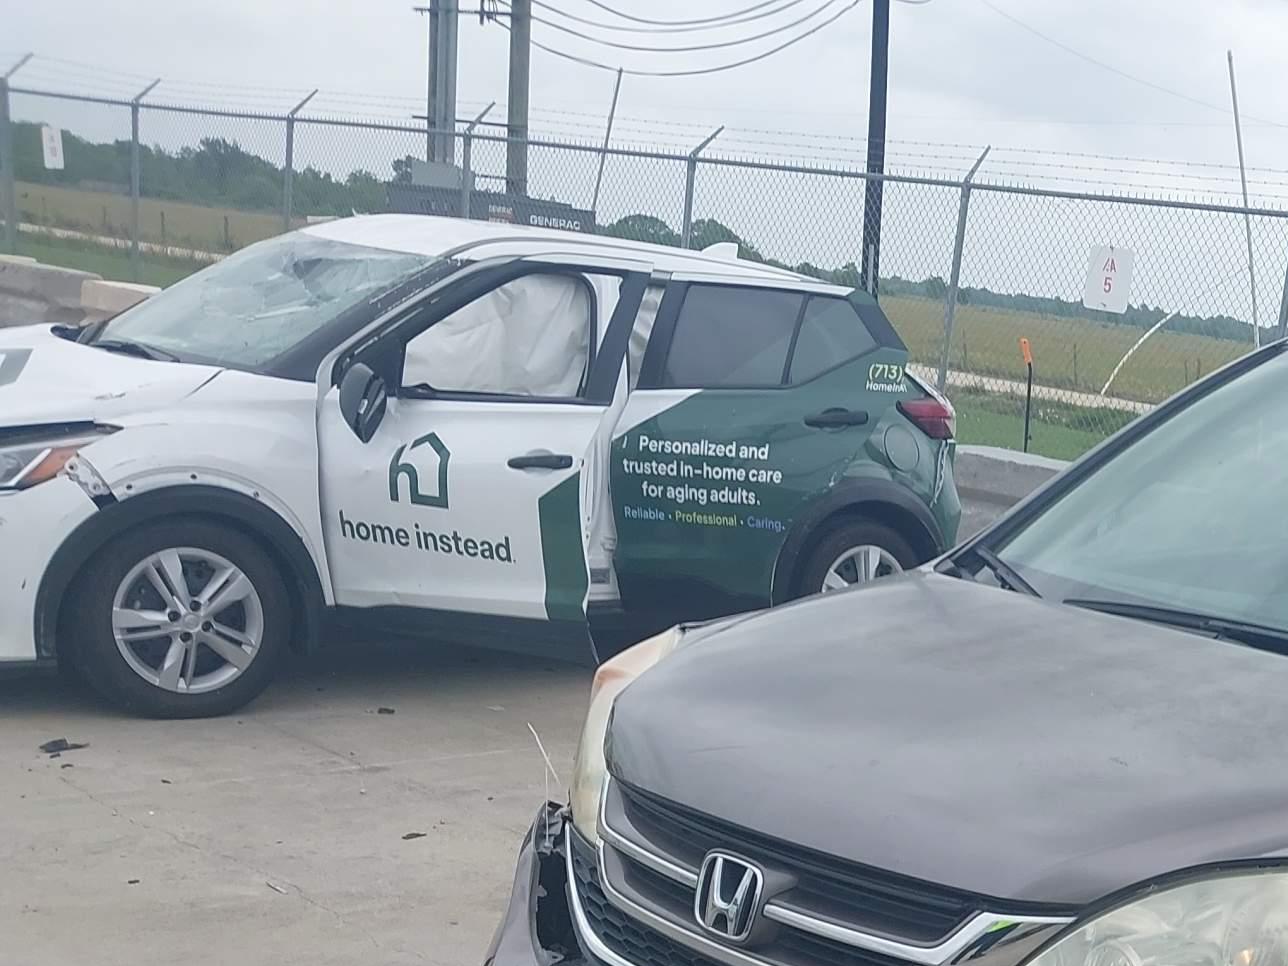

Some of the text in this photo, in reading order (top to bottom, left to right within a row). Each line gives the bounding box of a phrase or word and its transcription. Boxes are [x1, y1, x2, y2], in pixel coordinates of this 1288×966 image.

[529, 214, 581, 231] GENERAC
[1103, 276, 1113, 294] 5
[868, 363, 903, 383] (713)
[639, 434, 770, 461] Personalized and
[623, 458, 783, 484] trusted in-home care
[641, 480, 761, 507] for aging adults.
[339, 509, 410, 547] home
[624, 505, 786, 533] Reliable Professional Caring.
